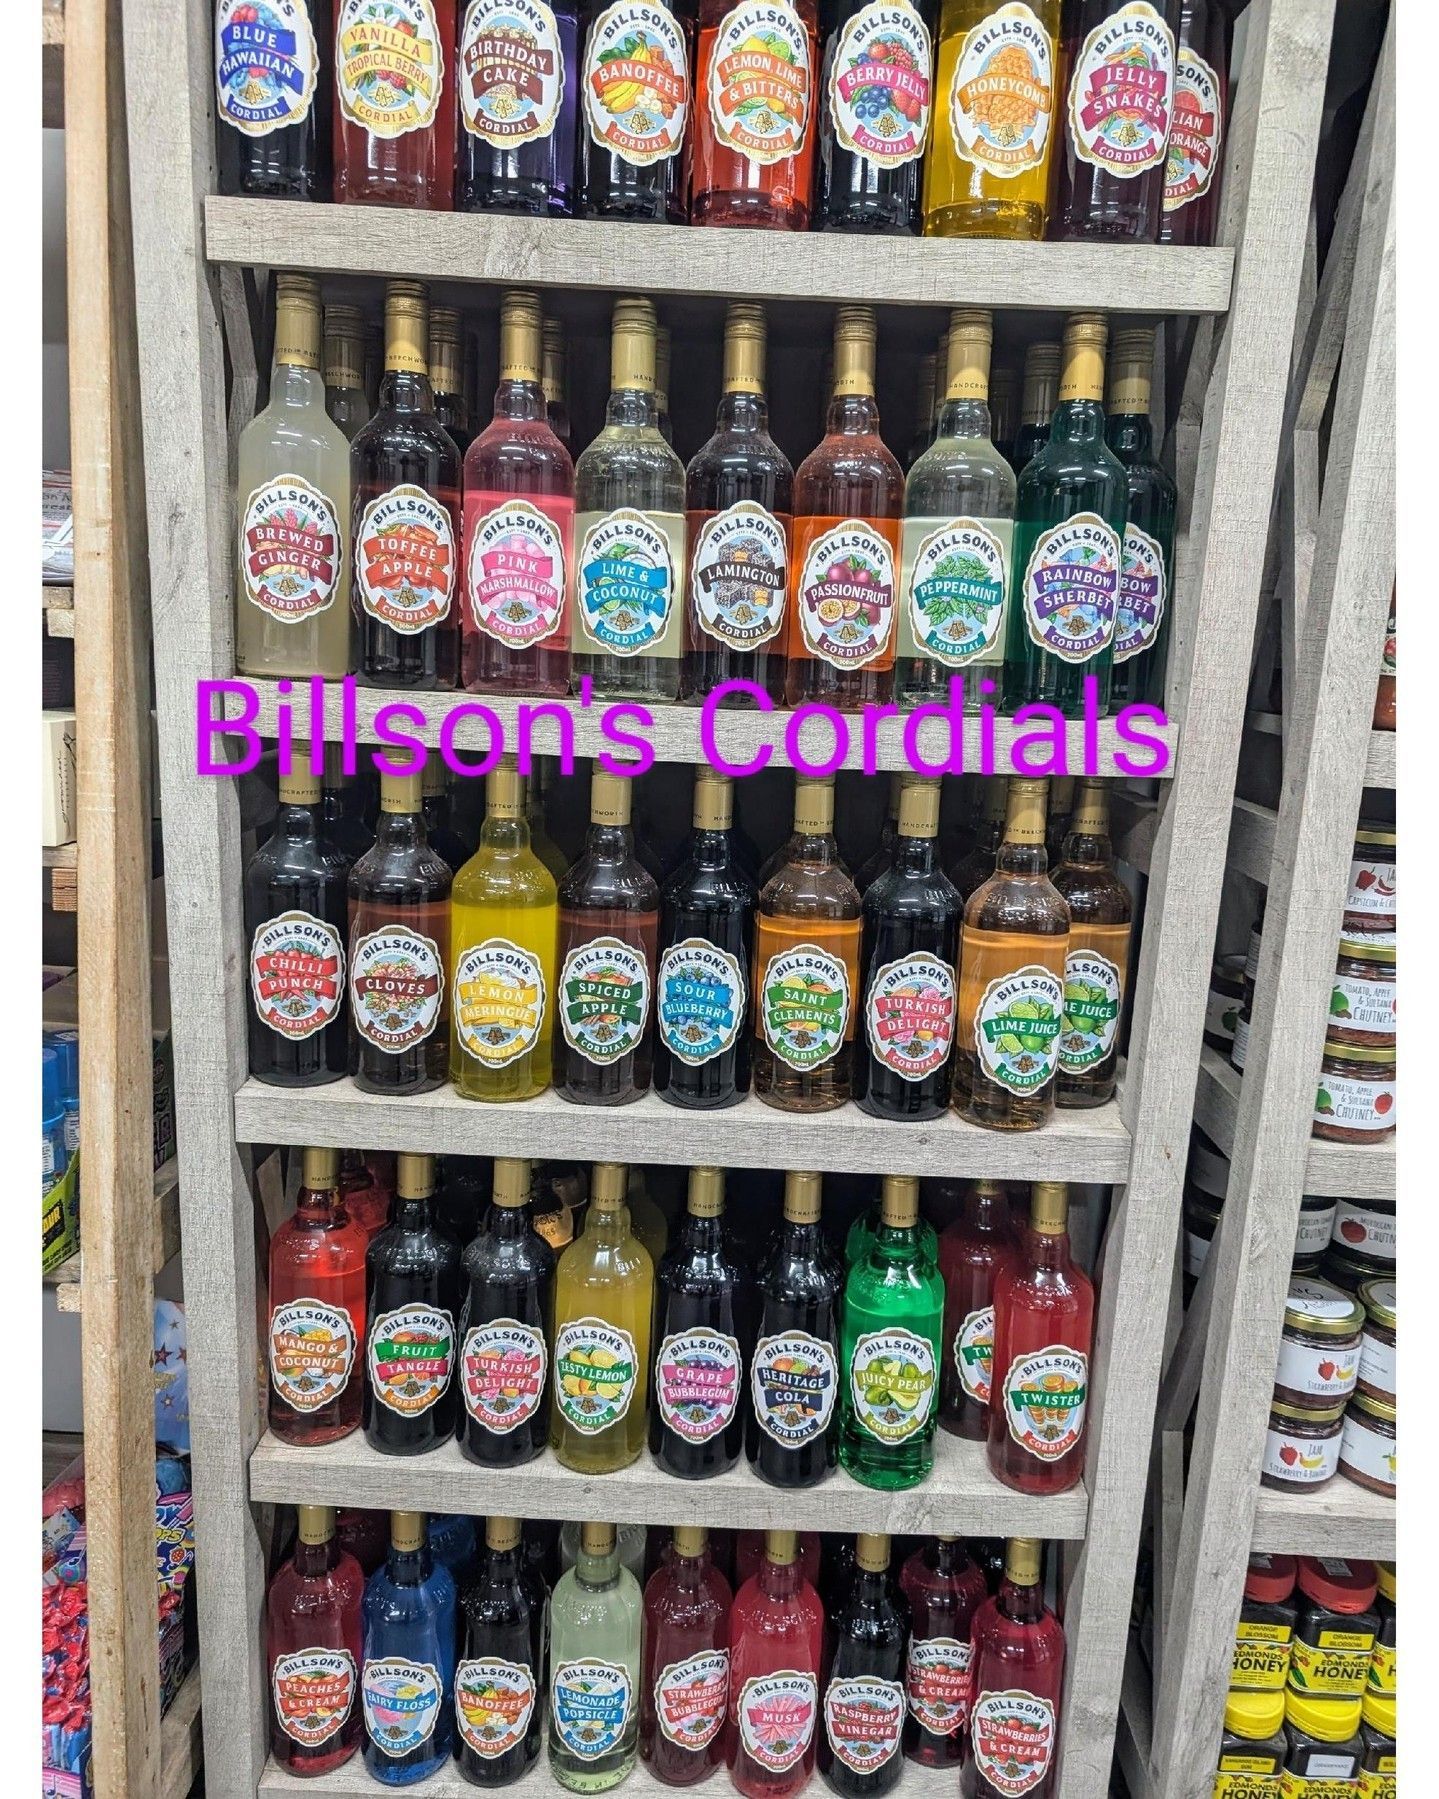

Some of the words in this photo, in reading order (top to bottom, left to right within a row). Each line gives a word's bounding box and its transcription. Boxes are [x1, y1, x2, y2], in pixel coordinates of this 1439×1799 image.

[232, 26, 277, 48] BLUE
[604, 9, 678, 49] BILLSON'S
[729, 10, 801, 49] BILLSON'S
[854, 12, 924, 52] BILLSON'S
[350, 26, 421, 58] VANILLA
[974, 21, 1047, 59] BILLSON'S
[1096, 21, 1169, 58] BILLSON'S
[470, 40, 547, 70] BIRTHDAY
[222, 50, 295, 78] HAWAIIAN
[348, 50, 392, 75] TROPICAL
[395, 55, 429, 84] BERRY
[483, 67, 529, 87] CAKE
[599, 63, 680, 97] BANOFFEE
[776, 62, 802, 87] LIME
[847, 67, 891, 86] BERRY
[895, 70, 925, 99] JELLY
[1105, 67, 1156, 88] JELLY
[730, 87, 740, 101] &
[743, 81, 798, 109] BITTERS
[967, 77, 1046, 108] HONEYCOMB
[231, 107, 282, 120] CORDIAL
[358, 106, 412, 122] CORDIAL
[1093, 94, 1161, 117] SNAKES
[479, 119, 532, 133] CORDIAL
[612, 129, 664, 149] CORDIAL
[859, 135, 911, 152] CORDIAL
[1099, 147, 1150, 161] CORDIAL
[255, 490, 327, 521] BILLSON'S
[373, 501, 444, 530] BILLSON'S
[483, 516, 553, 545] BILLSON'S
[711, 518, 780, 547] BILLSON'S
[256, 529, 323, 551] BREWED
[593, 525, 661, 554] BILLSON'S
[927, 533, 996, 562] BILLSON'S
[1046, 529, 1114, 558] BILLSON'S
[379, 539, 436, 560] TOFFEE
[817, 536, 886, 565] BILLSON'S
[258, 552, 320, 571] GINGER
[382, 562, 433, 578] APPLE
[497, 554, 538, 573] PINK
[602, 563, 635, 578] LIME
[639, 571, 649, 582] &
[707, 565, 780, 586] LAMINGTON
[1043, 569, 1112, 588] RAINBOW
[480, 580, 554, 596] MARSHMALLOW
[593, 587, 658, 604] COCONUT
[811, 584, 888, 605] PASSIONFRUIT
[919, 581, 998, 602] PEPPERMINT
[263, 593, 314, 610] CORDIAL
[1044, 591, 1111, 610] SHERBET
[382, 605, 432, 620] CORDIAL
[600, 630, 649, 644] CORDIAL
[719, 624, 768, 638] CORDIAL
[823, 642, 872, 657] CORDIAL
[932, 639, 982, 654] CORDIAL
[1051, 634, 1100, 650] CORDIAL
[263, 925, 331, 948] BILLSON'S
[362, 939, 428, 962] BILLSON'S
[270, 959, 323, 974] CHILLI
[466, 953, 531, 975] BILLSON'S
[574, 951, 638, 972] BILLSON'S
[667, 951, 729, 975] BILLSON'S
[776, 958, 839, 981] BILLSON'S
[270, 978, 323, 990] PUNCH
[885, 966, 950, 988] BILLSON'S
[366, 979, 425, 994] CLOVES
[470, 985, 525, 1001] LEMON
[579, 983, 631, 999] SPICED
[675, 984, 716, 1000] SOUR
[997, 980, 1059, 1001] BILLSON'S
[784, 989, 827, 1006] SAINT
[465, 1006, 531, 1019] MERINGUE
[582, 1004, 628, 1014] APPLE
[666, 1003, 727, 1020] BLUEBERRY
[885, 999, 946, 1014] TURKISH
[1080, 1002, 1111, 1018] JUICE
[1353, 1007, 1392, 1023] CHUTNEY
[273, 1015, 321, 1028] CORDIAL
[773, 1011, 836, 1025] CLEMENTS
[887, 1019, 946, 1033] DELIGHT
[370, 1029, 418, 1042] CORDIAL
[992, 1020, 1026, 1031] LIME
[1029, 1020, 1058, 1035] JUICE
[581, 1040, 627, 1053] CORDIAL
[672, 1038, 716, 1053] CORDIAL
[780, 1045, 826, 1060] CORDIAL
[892, 1055, 937, 1070] CORDIAL
[1001, 1071, 1046, 1085] CORDIAL
[1336, 1104, 1374, 1120] CHUTNEY
[280, 1311, 340, 1328] BILLSON'S
[383, 1316, 444, 1334] BILLSON'S
[279, 1337, 326, 1352] MANGO
[329, 1344, 338, 1352] &
[474, 1331, 535, 1349] BILLSON'S
[564, 1330, 622, 1350] BILLSON'S
[393, 1345, 437, 1355] FRUIT
[670, 1340, 730, 1358] BILLSON'S
[765, 1344, 825, 1363] BILLSON'S
[864, 1341, 925, 1359] BILLSON'S
[280, 1357, 339, 1368] COCONUT
[387, 1361, 440, 1373] TANGLE
[473, 1358, 532, 1373] TURKISH
[561, 1362, 586, 1375] ZESTY
[589, 1369, 627, 1380] LEMON
[1023, 1358, 1082, 1375] BILLSON'S
[476, 1378, 534, 1388] DELIGHT
[677, 1368, 722, 1381] GRAPE
[762, 1369, 824, 1388] HERITAGE
[861, 1373, 895, 1386] JUICY
[898, 1380, 926, 1389] PEAR
[669, 1388, 729, 1399] BUBBLEGUM
[775, 1392, 810, 1403] COLA
[1021, 1393, 1081, 1405] TWISTER
[1233, 1650, 1283, 1660] EDMONDS
[284, 1658, 343, 1674] BILLSON'S
[1233, 1658, 1287, 1672] HONEY
[370, 1669, 426, 1682] BILLSON'S
[465, 1668, 521, 1683] BILLSON'S
[563, 1669, 620, 1683] BILLSON'S
[286, 1682, 340, 1693] PEACHES
[755, 1681, 810, 1696] BILLSON'S
[838, 1688, 895, 1701] BILLSON'S
[289, 1699, 296, 1708] &
[300, 1696, 340, 1707] CREAM
[368, 1692, 393, 1709] FAIRY
[397, 1699, 431, 1710] FLOSS
[462, 1694, 524, 1710] BANOFFEE
[561, 1689, 620, 1706] LEMONADE
[564, 1709, 617, 1719] POPSICLE
[763, 1713, 800, 1723] MUSK
[833, 1704, 896, 1722] RASPBERRY
[988, 1702, 1047, 1719] BILLSON'S
[838, 1726, 892, 1736] VINEGAR
[982, 1720, 1046, 1742] STRAWBERRIES
[990, 1743, 997, 1751] &
[1001, 1744, 1040, 1756] CREAM
